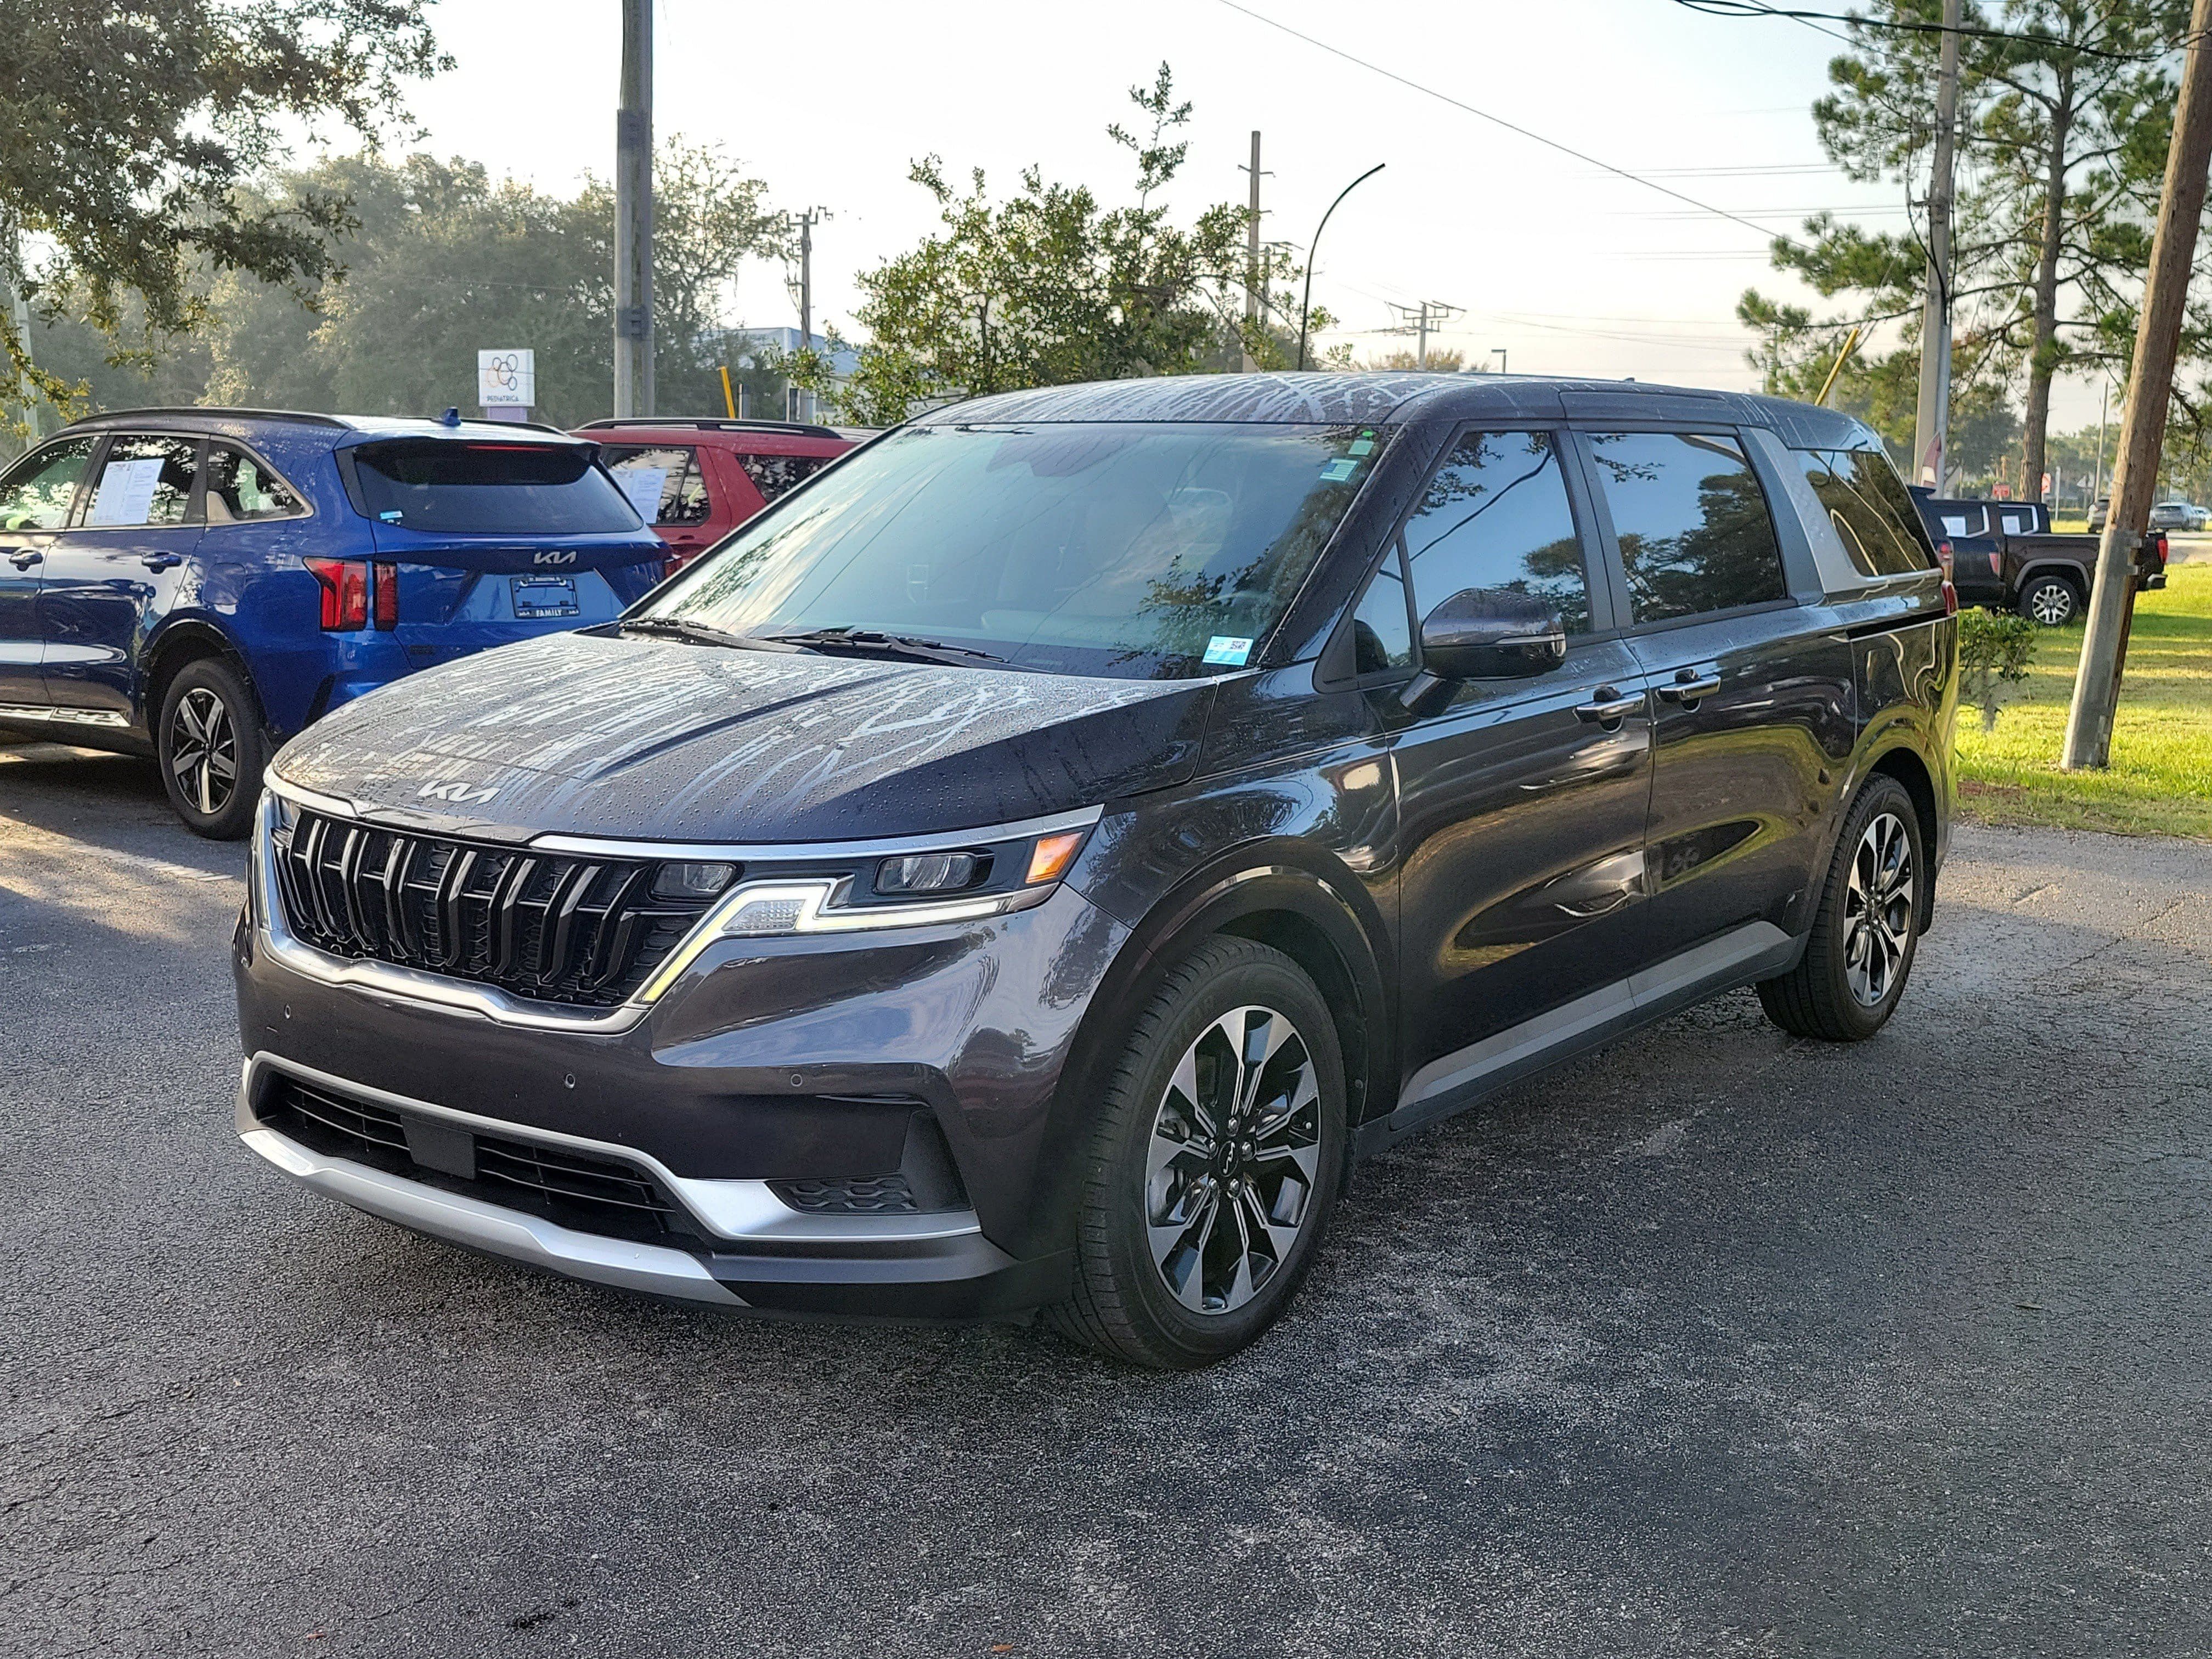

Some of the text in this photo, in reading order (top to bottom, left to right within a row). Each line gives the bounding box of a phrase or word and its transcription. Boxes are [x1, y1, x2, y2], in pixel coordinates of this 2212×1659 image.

[534, 551, 577, 564] KIA
[536, 609, 562, 617] FAMILY
[416, 780, 501, 805] KIA
